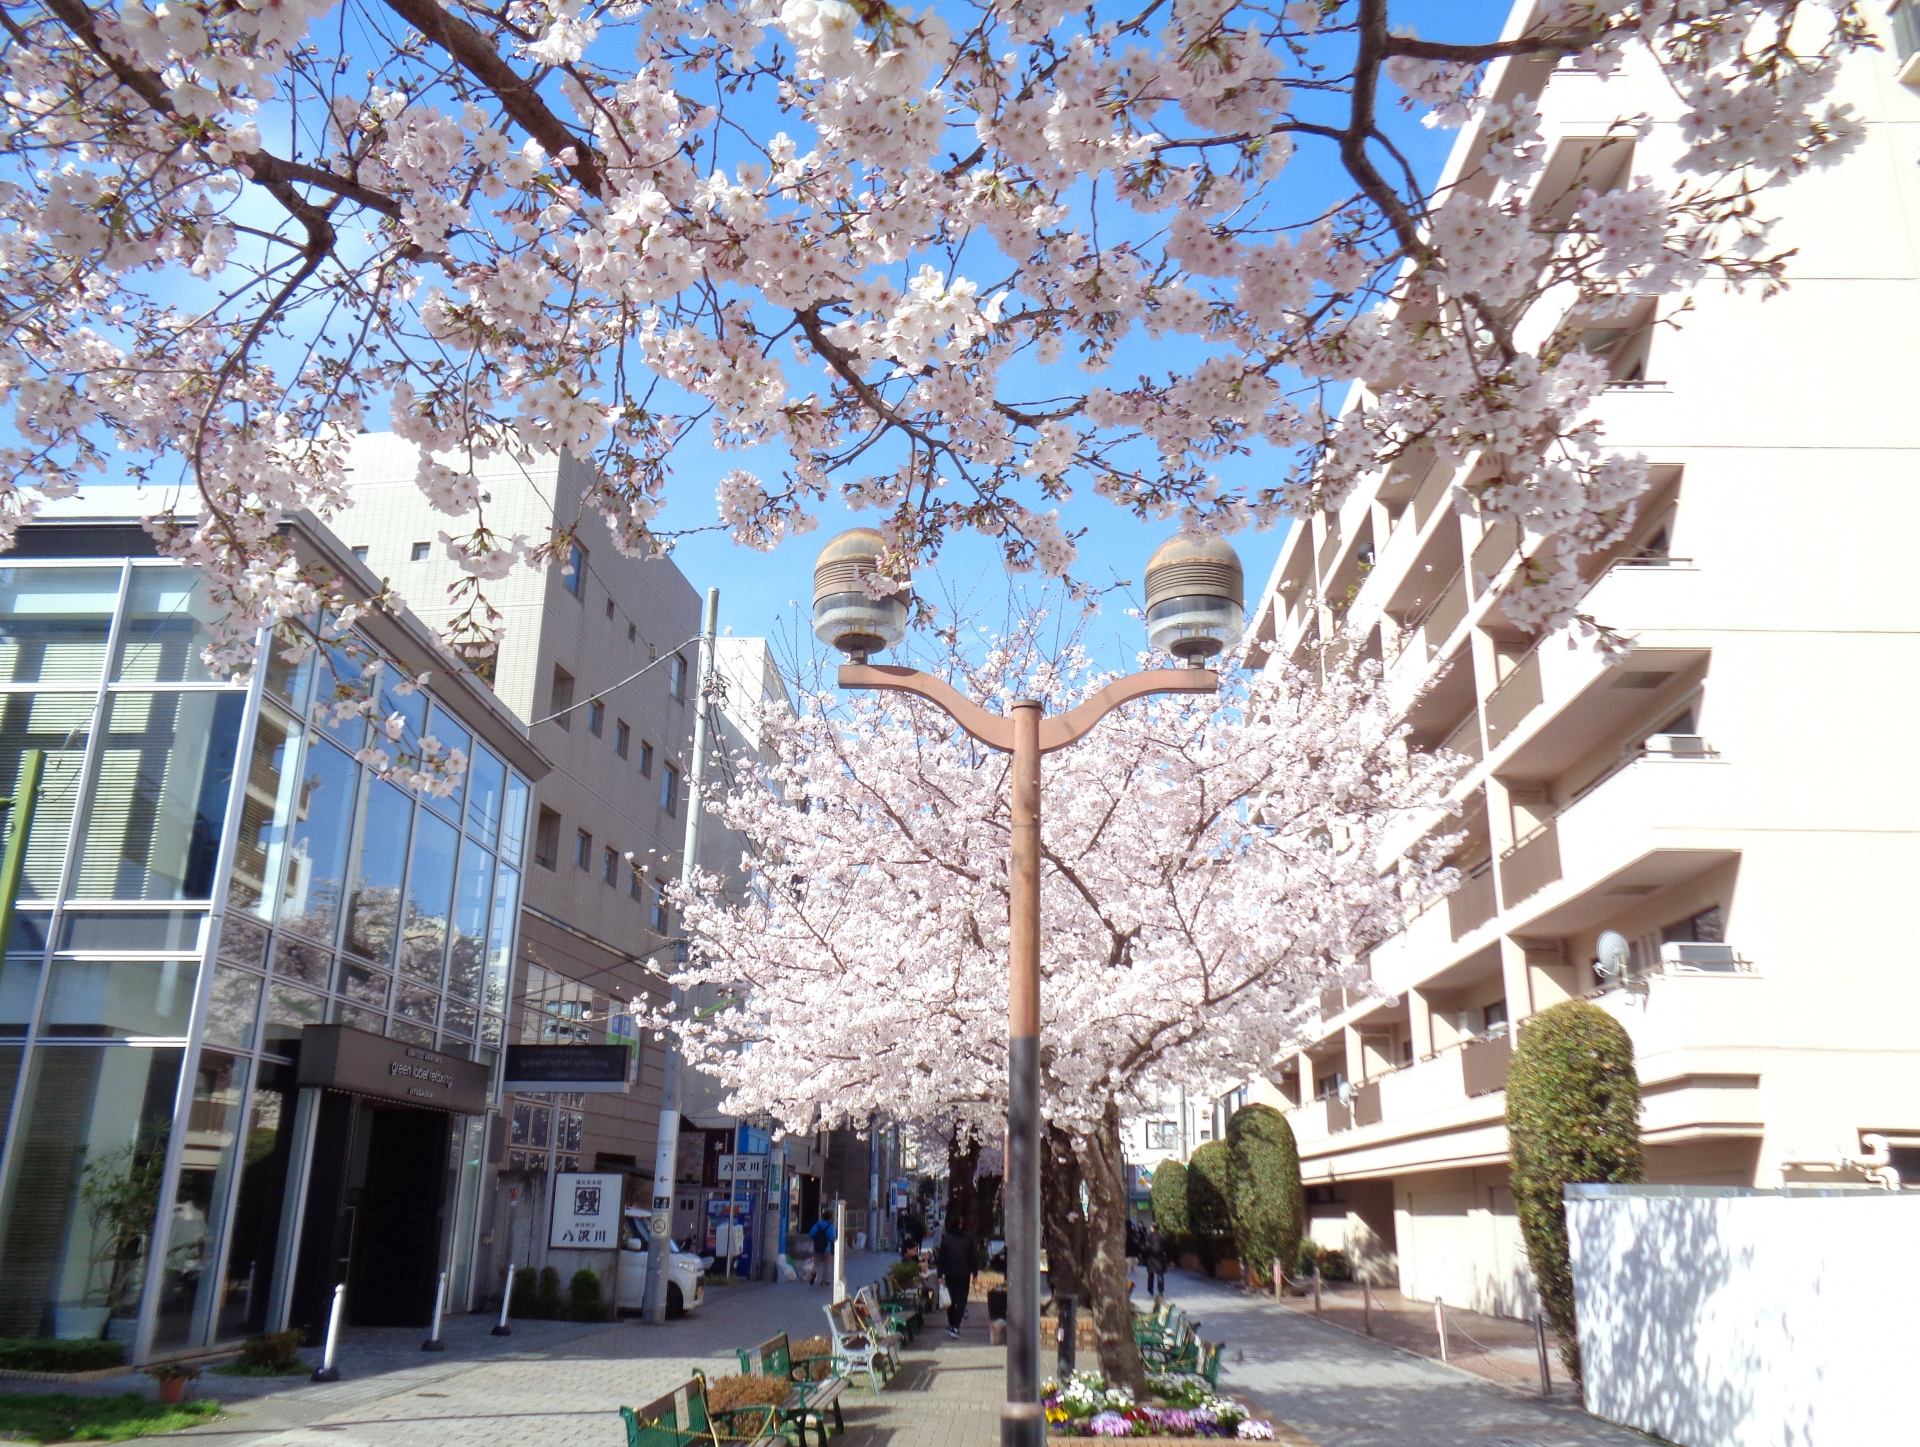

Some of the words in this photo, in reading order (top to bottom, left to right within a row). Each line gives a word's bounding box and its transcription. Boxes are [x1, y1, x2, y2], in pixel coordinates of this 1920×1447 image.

[521, 1059, 547, 1068] green
[391, 1062, 411, 1076] green
[412, 1065, 429, 1080] label
[429, 1069, 453, 1088] relaxing
[562, 1230, 606, 1243] 八沢川
